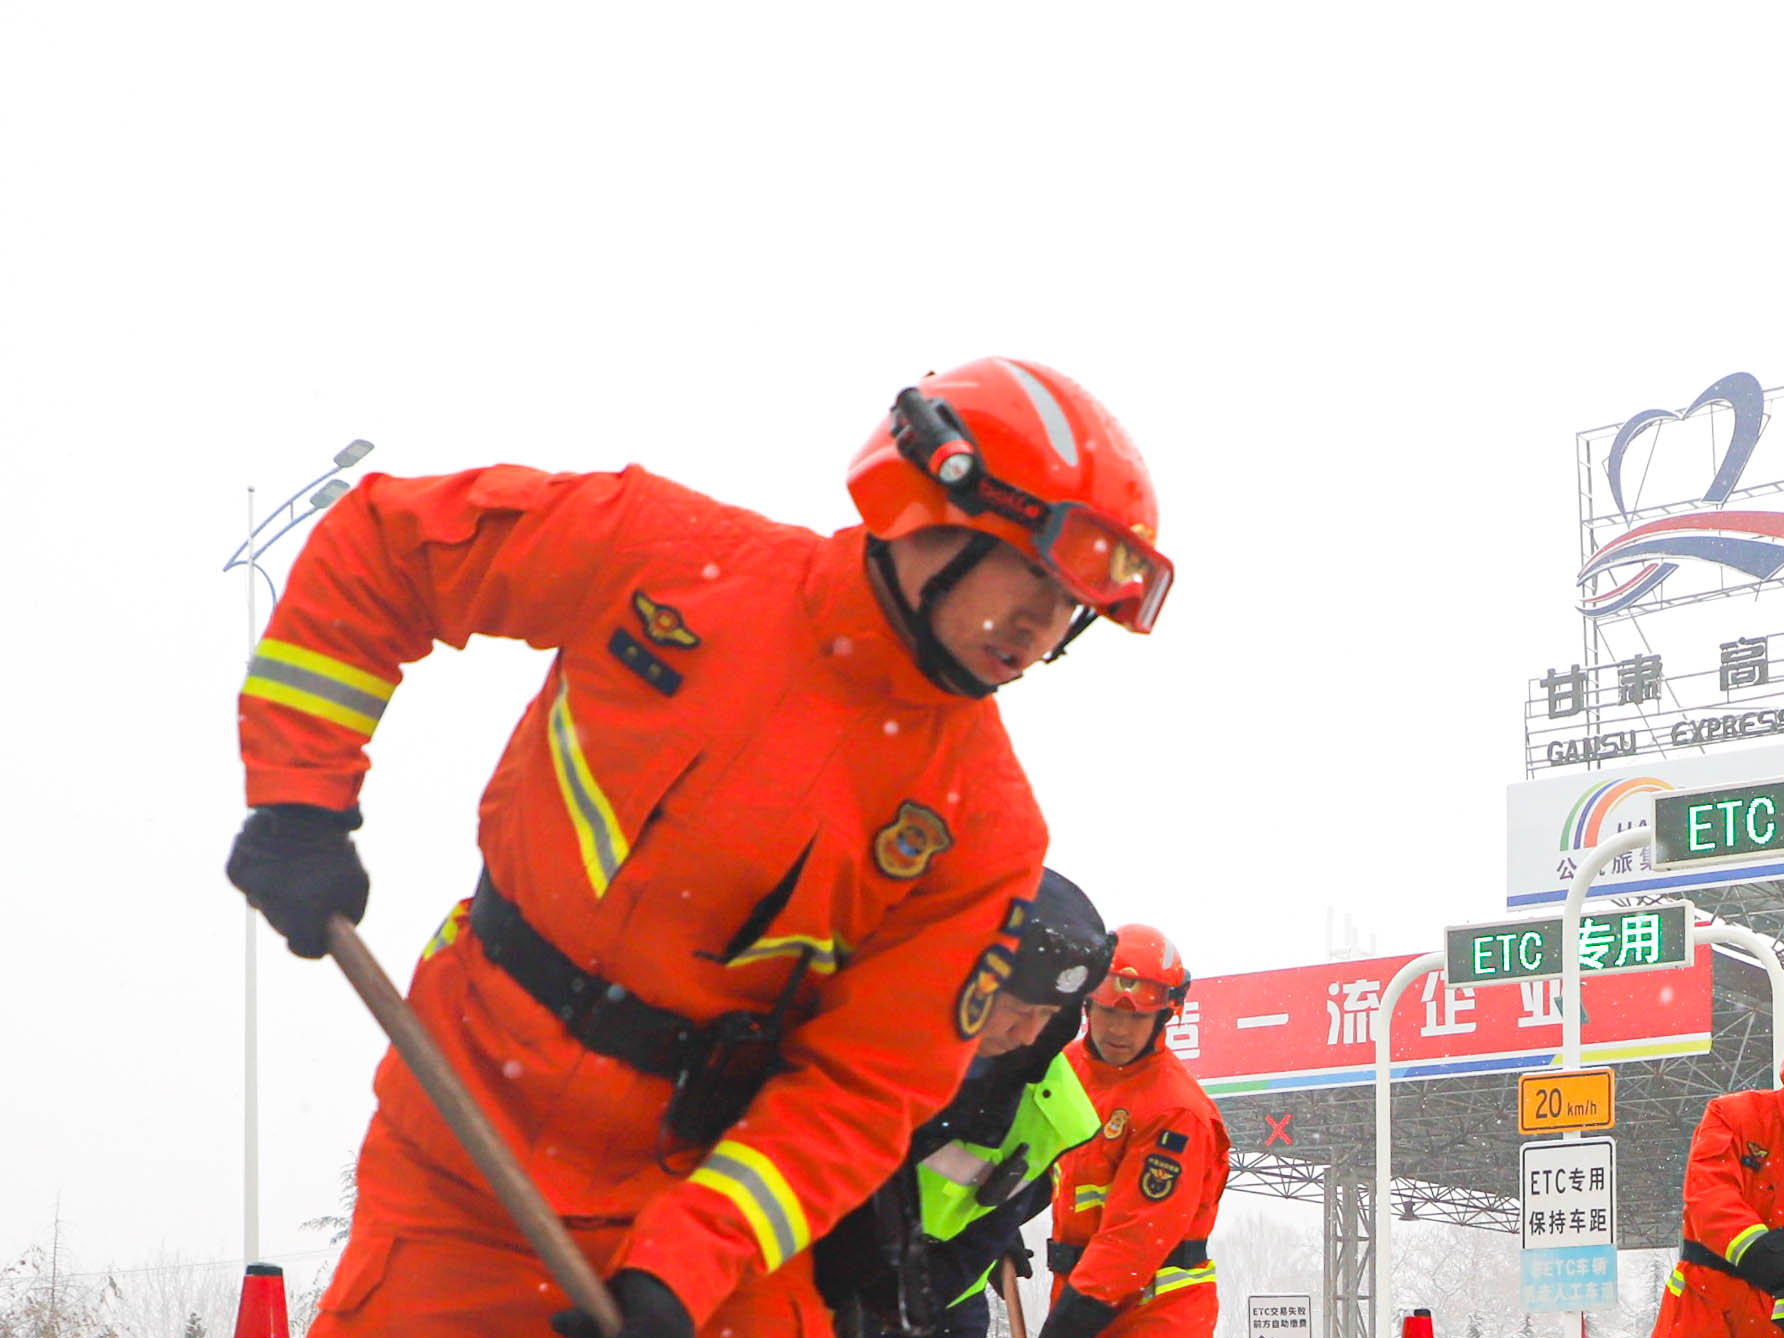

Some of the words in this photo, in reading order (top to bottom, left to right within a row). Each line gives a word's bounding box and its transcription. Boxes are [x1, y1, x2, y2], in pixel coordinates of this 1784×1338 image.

[1547, 730, 1637, 767] GANSU
[1688, 795, 1775, 853] ETC
[1473, 931, 1543, 975] ETC
[1578, 914, 1661, 970] 专用
[1535, 1087, 1563, 1119] 20
[1567, 1100, 1598, 1118] km/h
[1530, 1167, 1605, 1196] ETC专用
[1529, 1208, 1607, 1236] 保持车距
